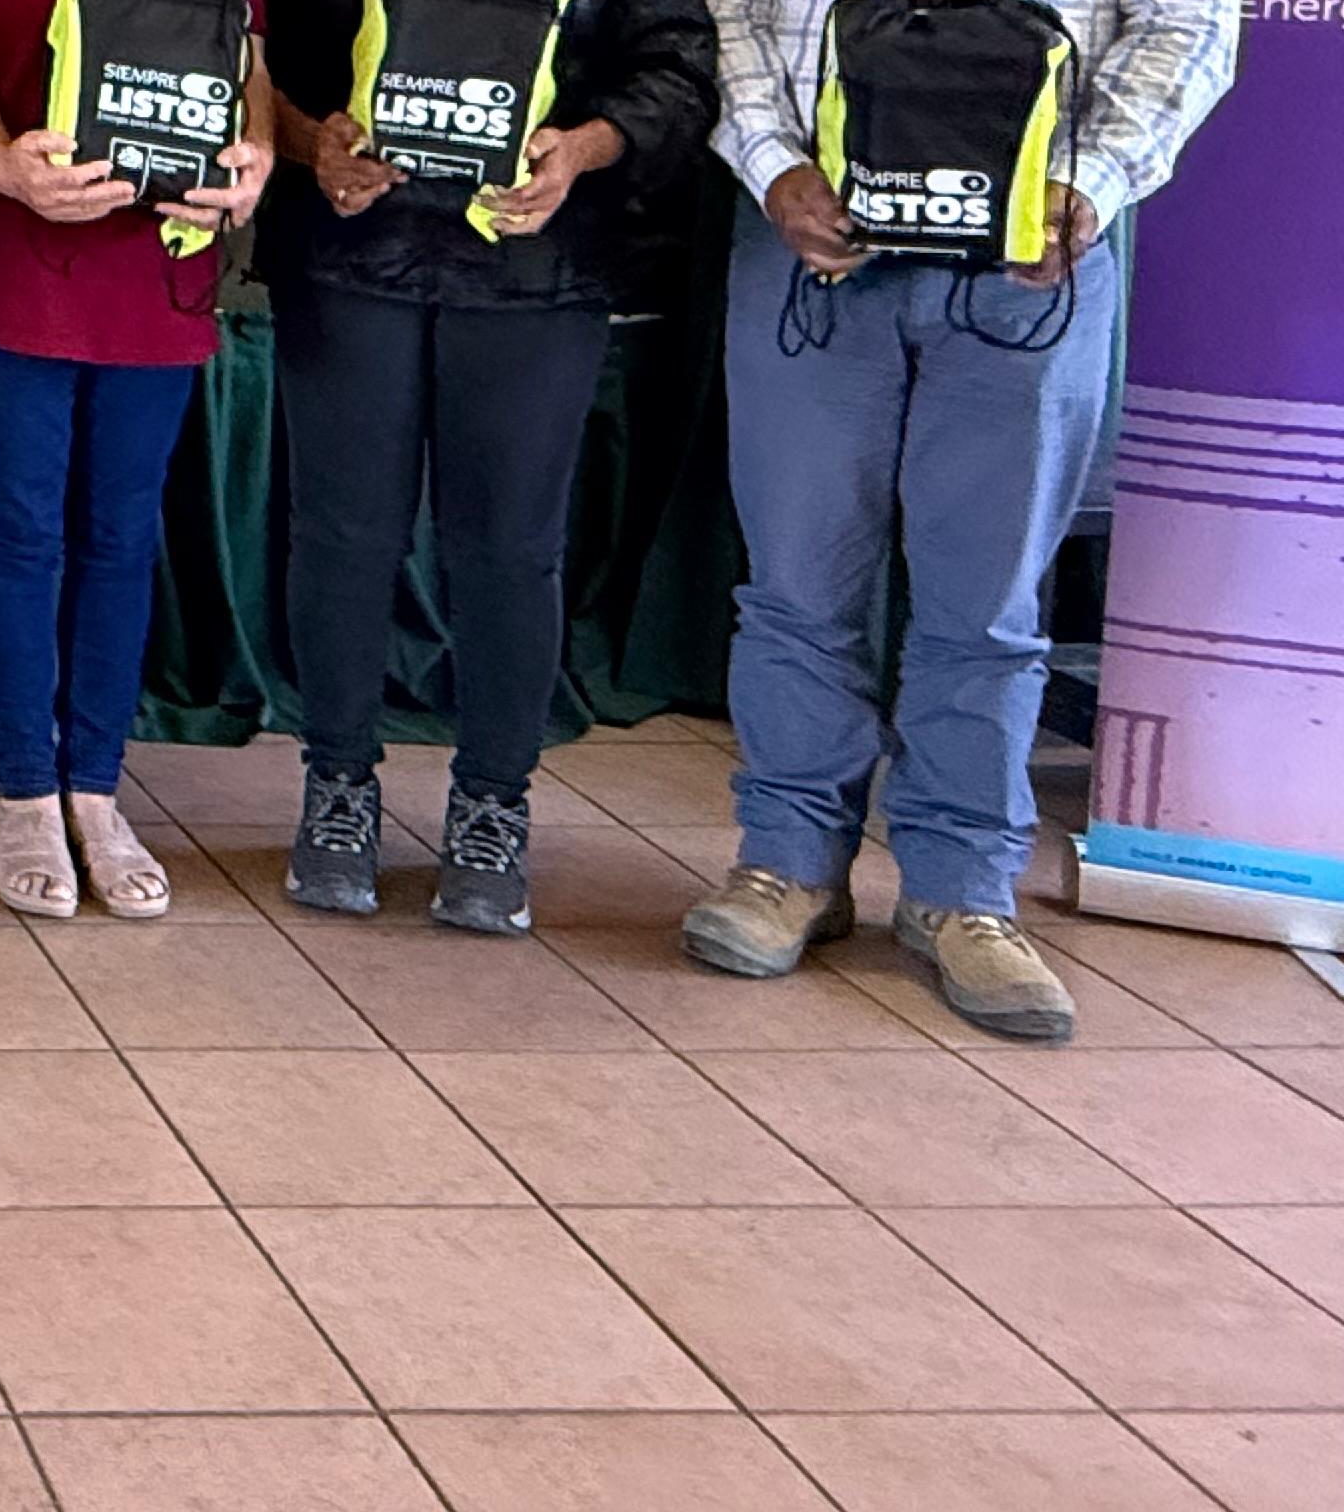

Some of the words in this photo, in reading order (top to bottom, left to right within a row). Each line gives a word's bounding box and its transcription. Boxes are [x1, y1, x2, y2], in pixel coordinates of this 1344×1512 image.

[103, 61, 179, 91] SIEMPRE
[381, 71, 457, 98] SIEMPRE
[98, 82, 229, 134] LISTOS
[375, 92, 512, 138] LISTOS
[848, 182, 992, 226] LISTOS
